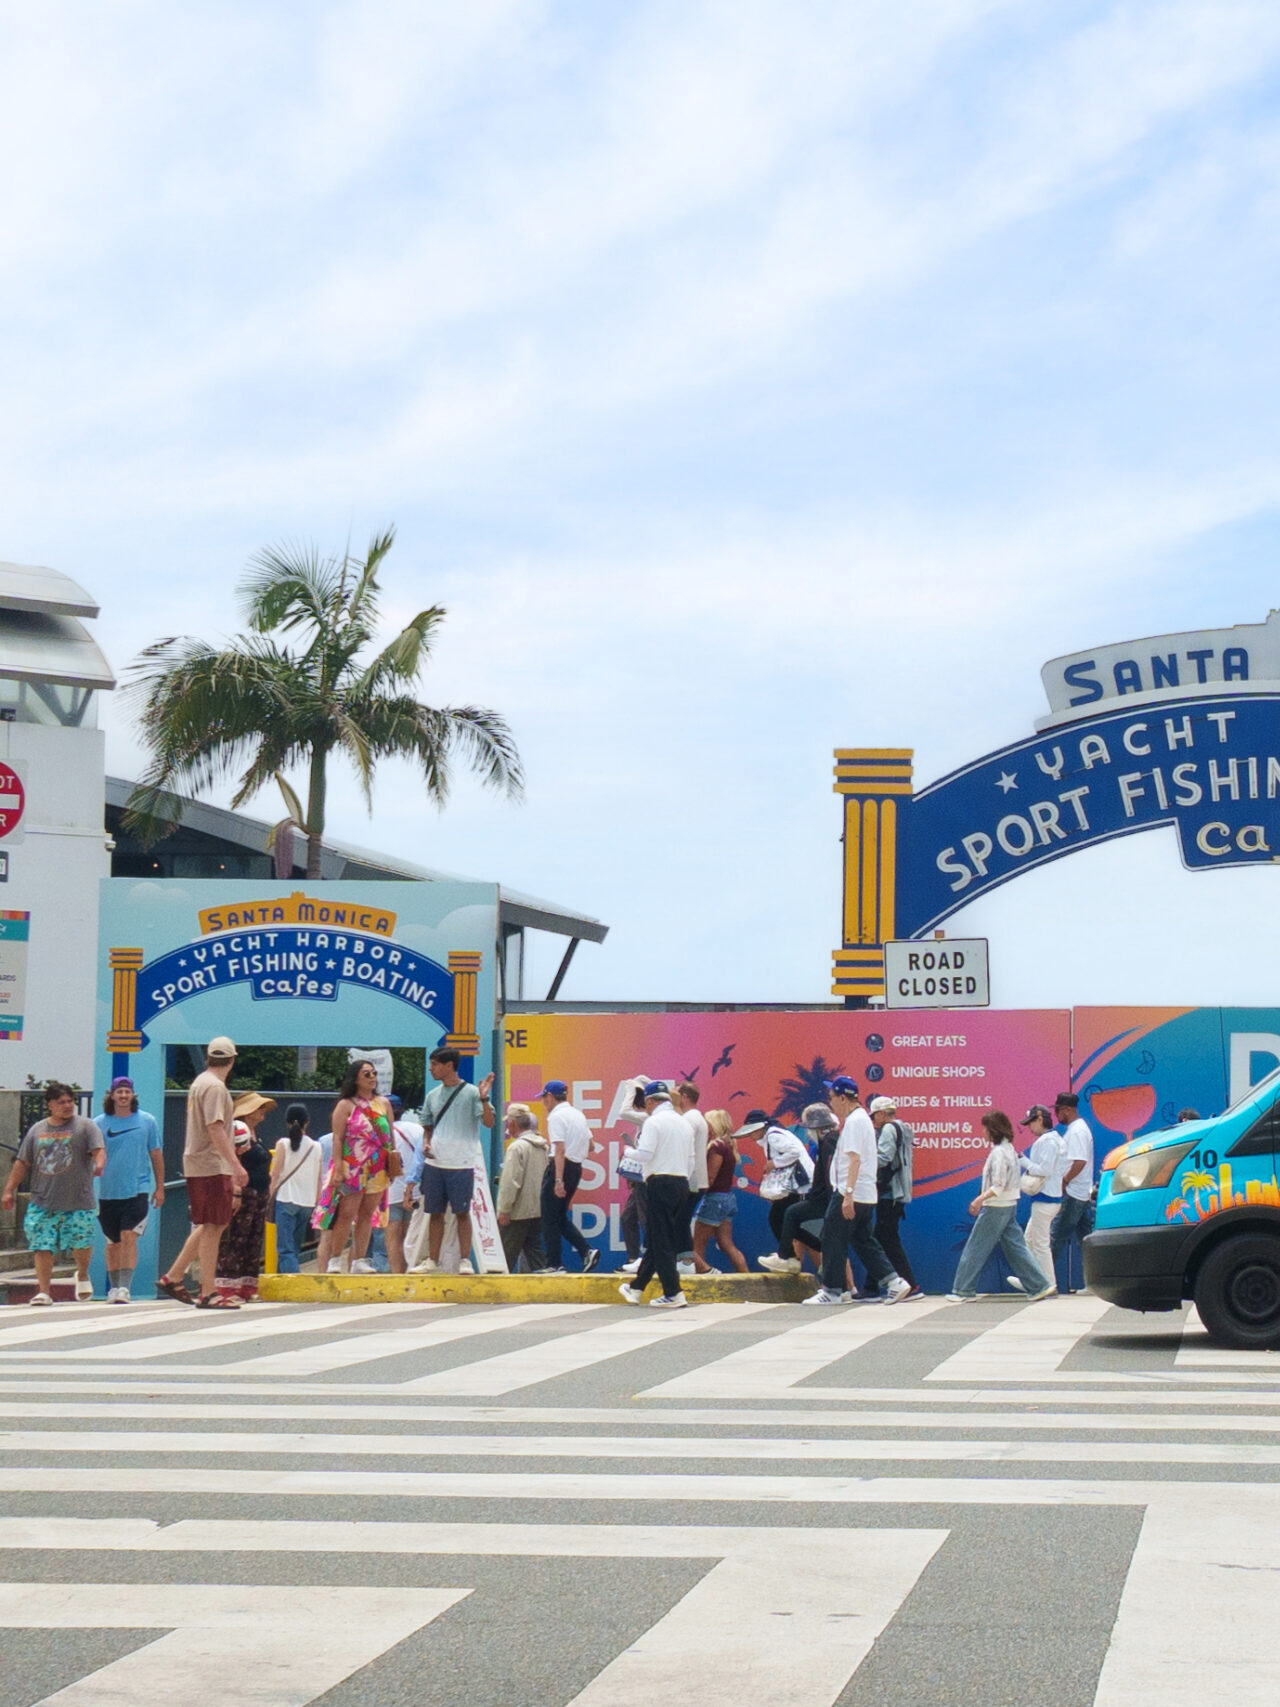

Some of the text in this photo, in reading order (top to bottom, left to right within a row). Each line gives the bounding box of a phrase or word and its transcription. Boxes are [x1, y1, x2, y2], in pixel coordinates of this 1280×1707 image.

[1063, 647, 1249, 707] SANTA
[1034, 711, 1236, 781] YACHT
[936, 786, 1090, 892] SPORT
[207, 903, 389, 932] SANTA MONICA
[194, 932, 402, 966] YACHT HARBOR
[908, 951, 965, 971] ROAD
[151, 952, 438, 1010] SPORT FISHING BOATING
[898, 976, 977, 996] CLOSED
[891, 1035, 967, 1047] GREAT EATS
[891, 1066, 985, 1078] UNIQUE SHOPS
[893, 1096, 992, 1107] RIDES & THRILLS
[962, 1122, 973, 1134] &
[1189, 1149, 1218, 1169] 10
